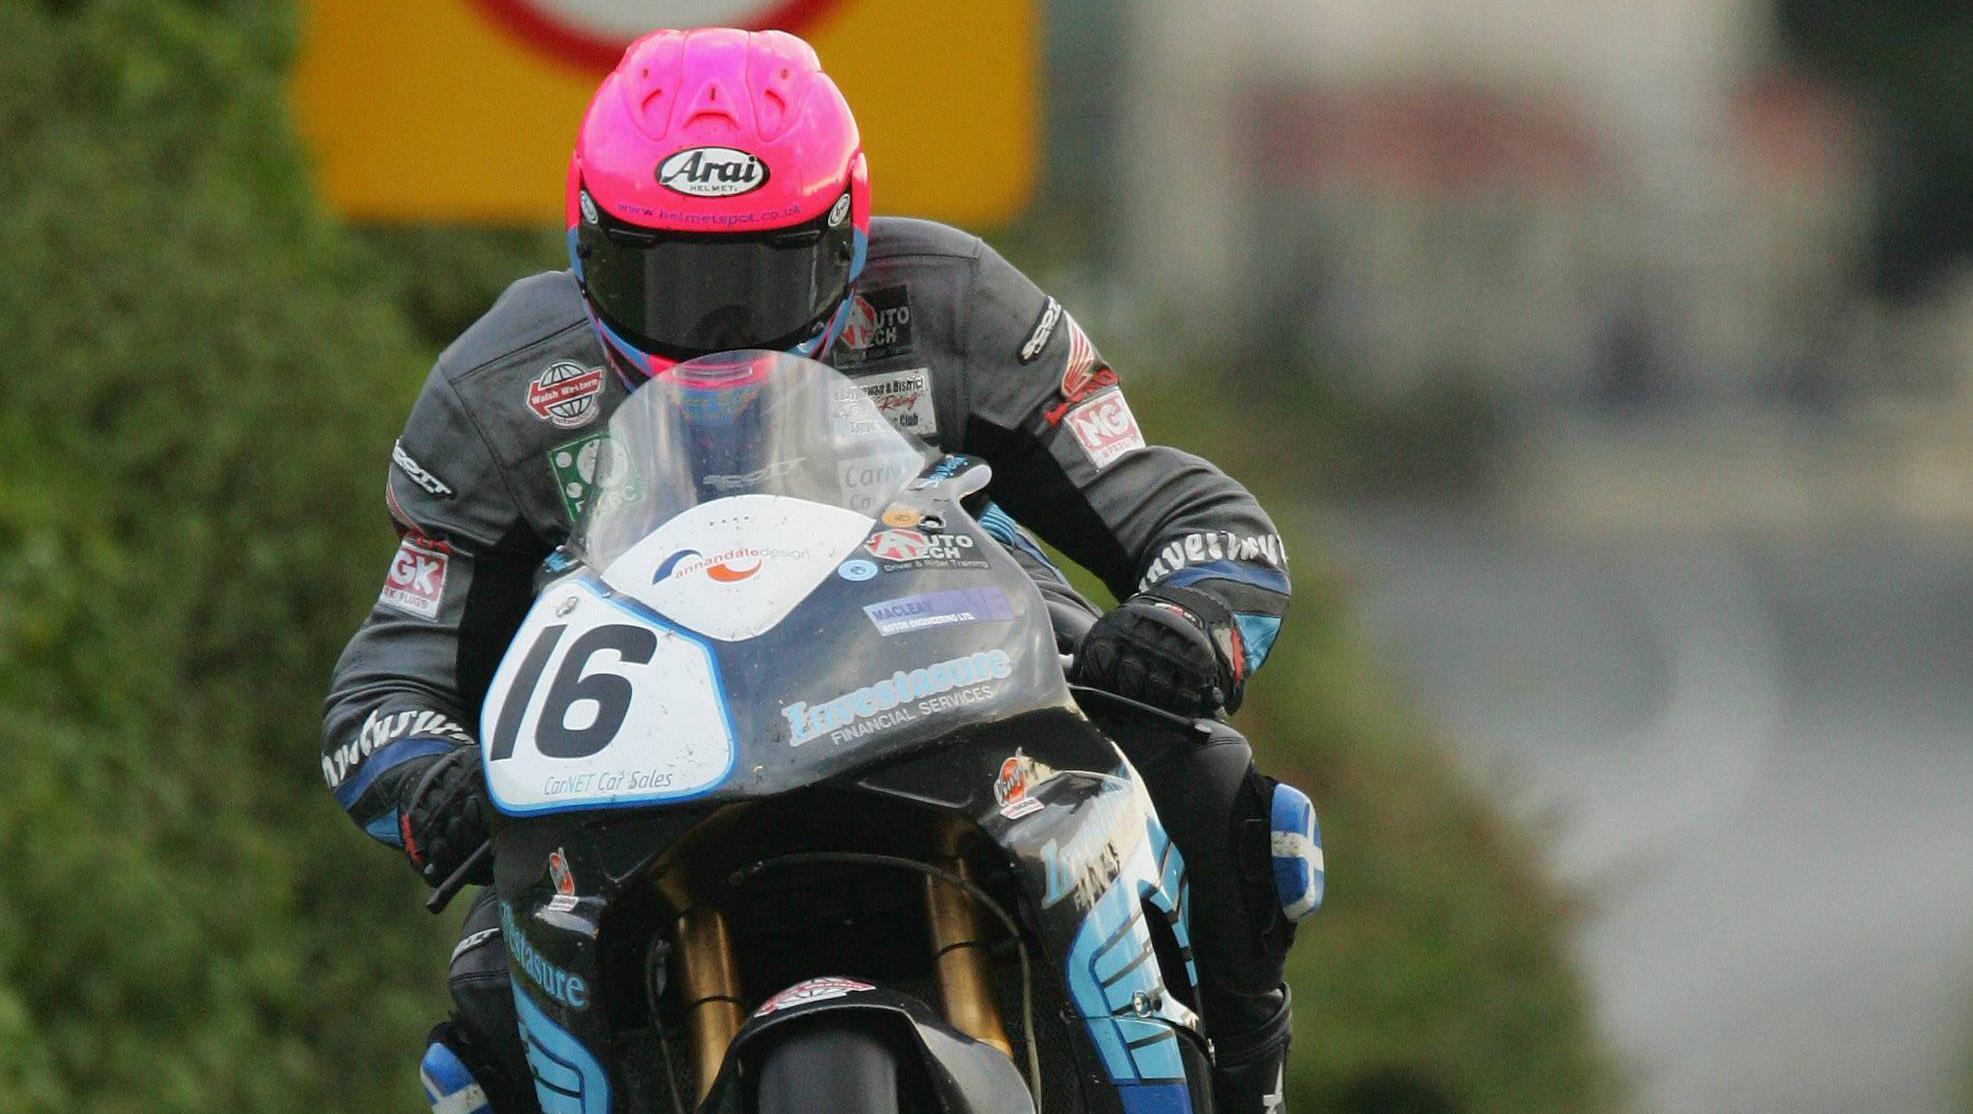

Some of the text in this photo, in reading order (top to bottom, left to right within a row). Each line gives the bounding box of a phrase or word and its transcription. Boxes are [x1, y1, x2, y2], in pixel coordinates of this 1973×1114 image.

[660, 150, 757, 184] Arai
[531, 390, 559, 404] Walsh
[1075, 398, 1131, 447] NG
[389, 549, 440, 595] GK
[489, 623, 658, 762] 16
[831, 685, 995, 745] FINANCIAL SERVICES
[543, 769, 673, 796] CarNET Car Sales
